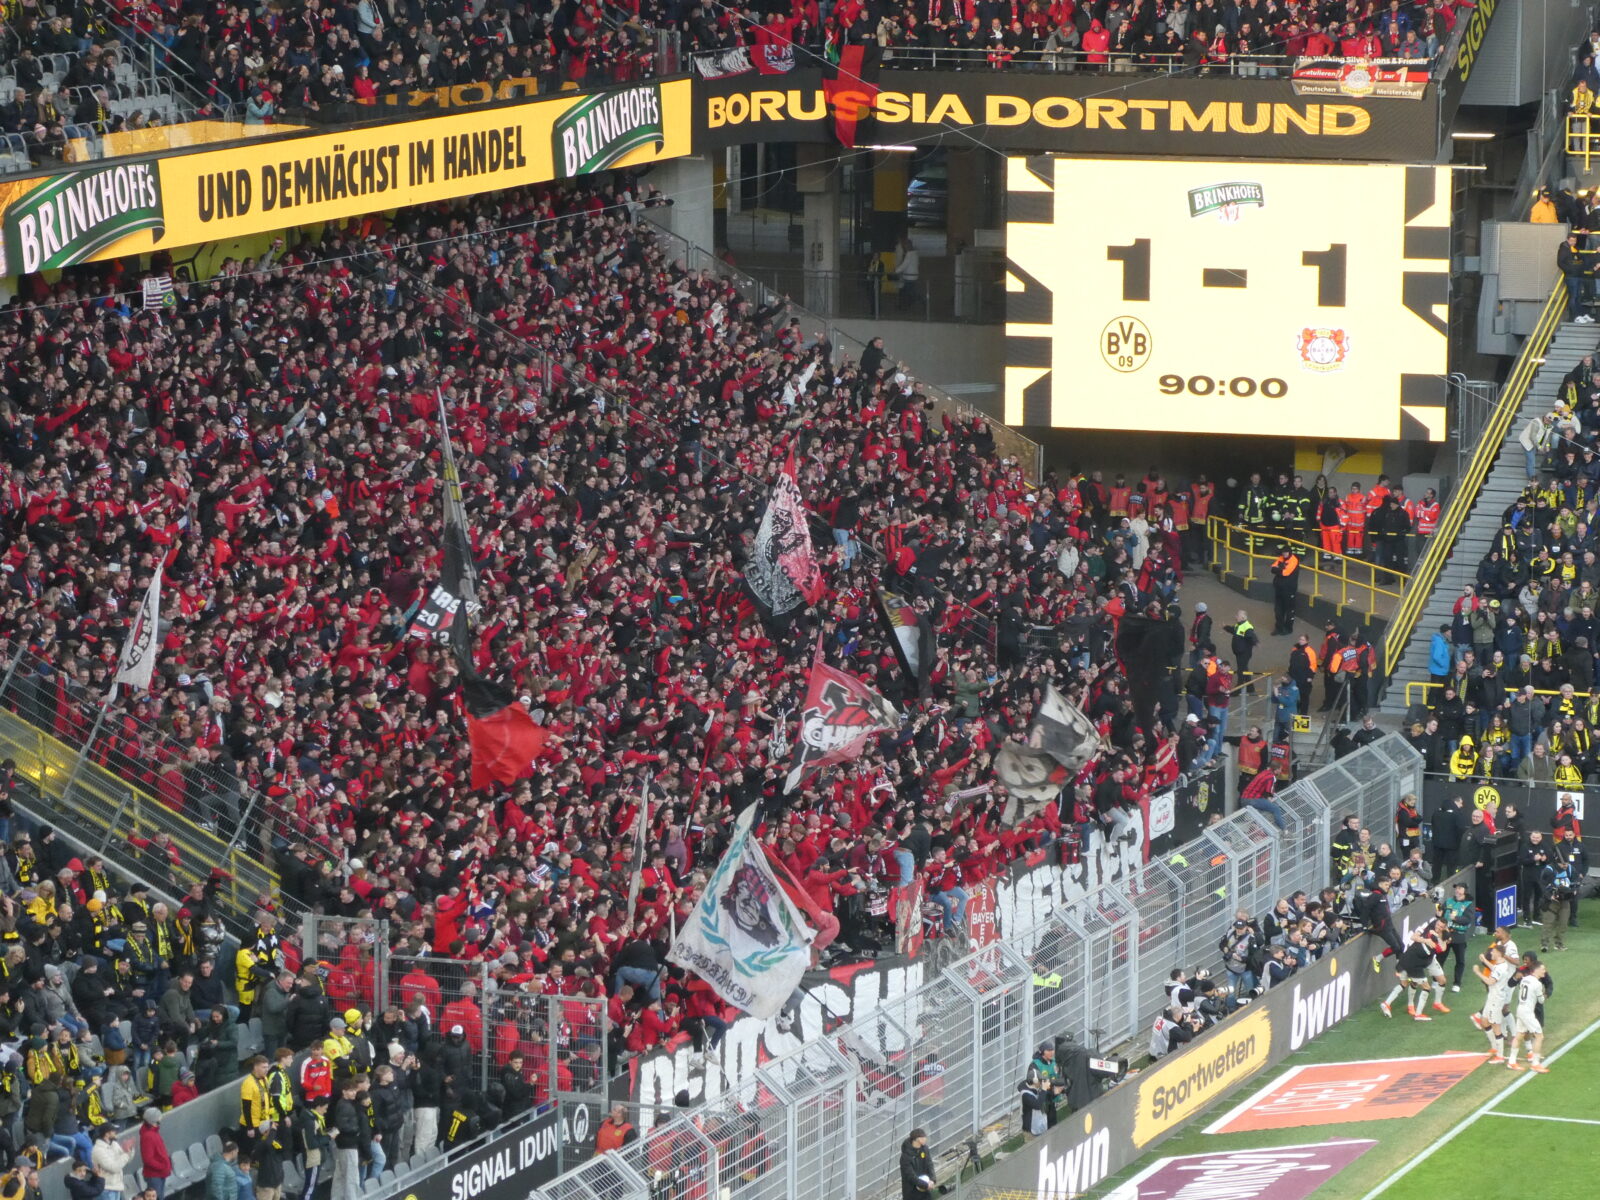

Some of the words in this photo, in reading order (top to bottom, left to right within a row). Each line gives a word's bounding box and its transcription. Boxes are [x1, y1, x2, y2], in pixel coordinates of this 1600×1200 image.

[1458, 0, 1496, 82] SIGN
[708, 89, 974, 129] BORUSSIA
[1301, 85, 1337, 93] Deutschen
[985, 95, 1371, 136] DORTMUND
[198, 168, 252, 223] UND
[261, 143, 400, 212] DEMNÄCHST
[408, 138, 435, 187] IM
[443, 124, 527, 181] HANDEL
[1107, 238, 1151, 301] 1
[1302, 243, 1347, 307] 1
[1107, 321, 1147, 355] BVB
[1118, 356, 1133, 368] 09
[1158, 374, 1288, 398] 90:00
[971, 911, 995, 925] BAYER
[1497, 895, 1515, 919] 1&1
[1290, 957, 1351, 1051] bwin
[1152, 1033, 1256, 1121] Sportwetten
[451, 1147, 516, 1200] SIGNAL
[519, 1116, 571, 1171] IDUNA
[1037, 1112, 1110, 1200] bwin
